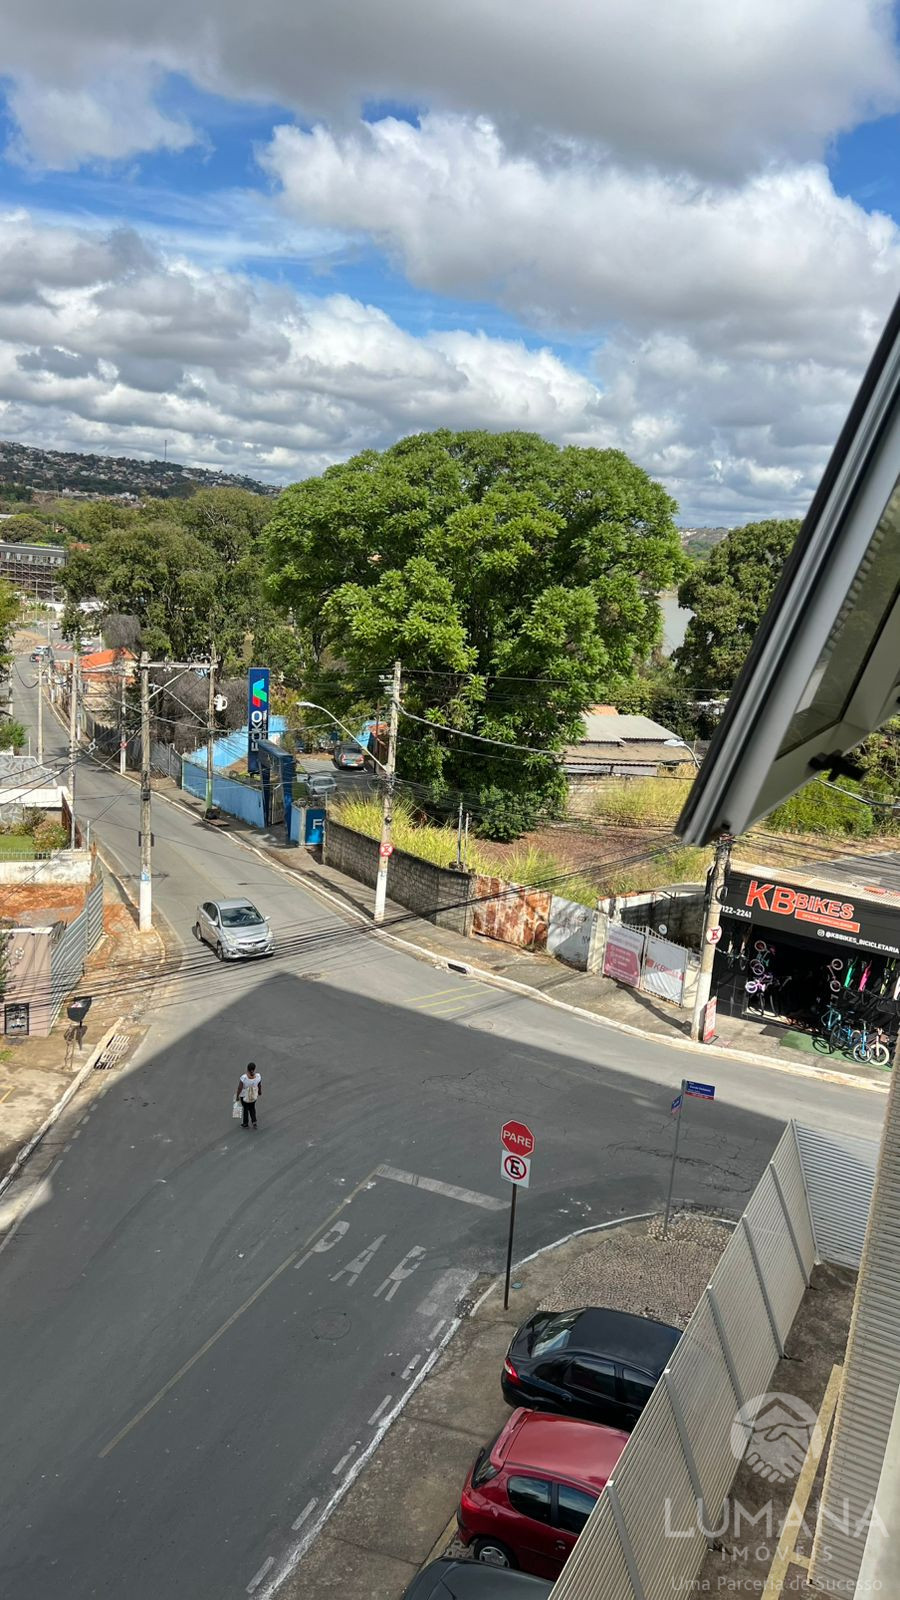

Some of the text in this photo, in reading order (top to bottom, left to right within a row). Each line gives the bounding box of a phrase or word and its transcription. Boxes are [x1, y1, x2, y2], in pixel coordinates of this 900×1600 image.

[745, 880, 855, 920] KB BIKES
[503, 1130, 532, 1149] PARE
